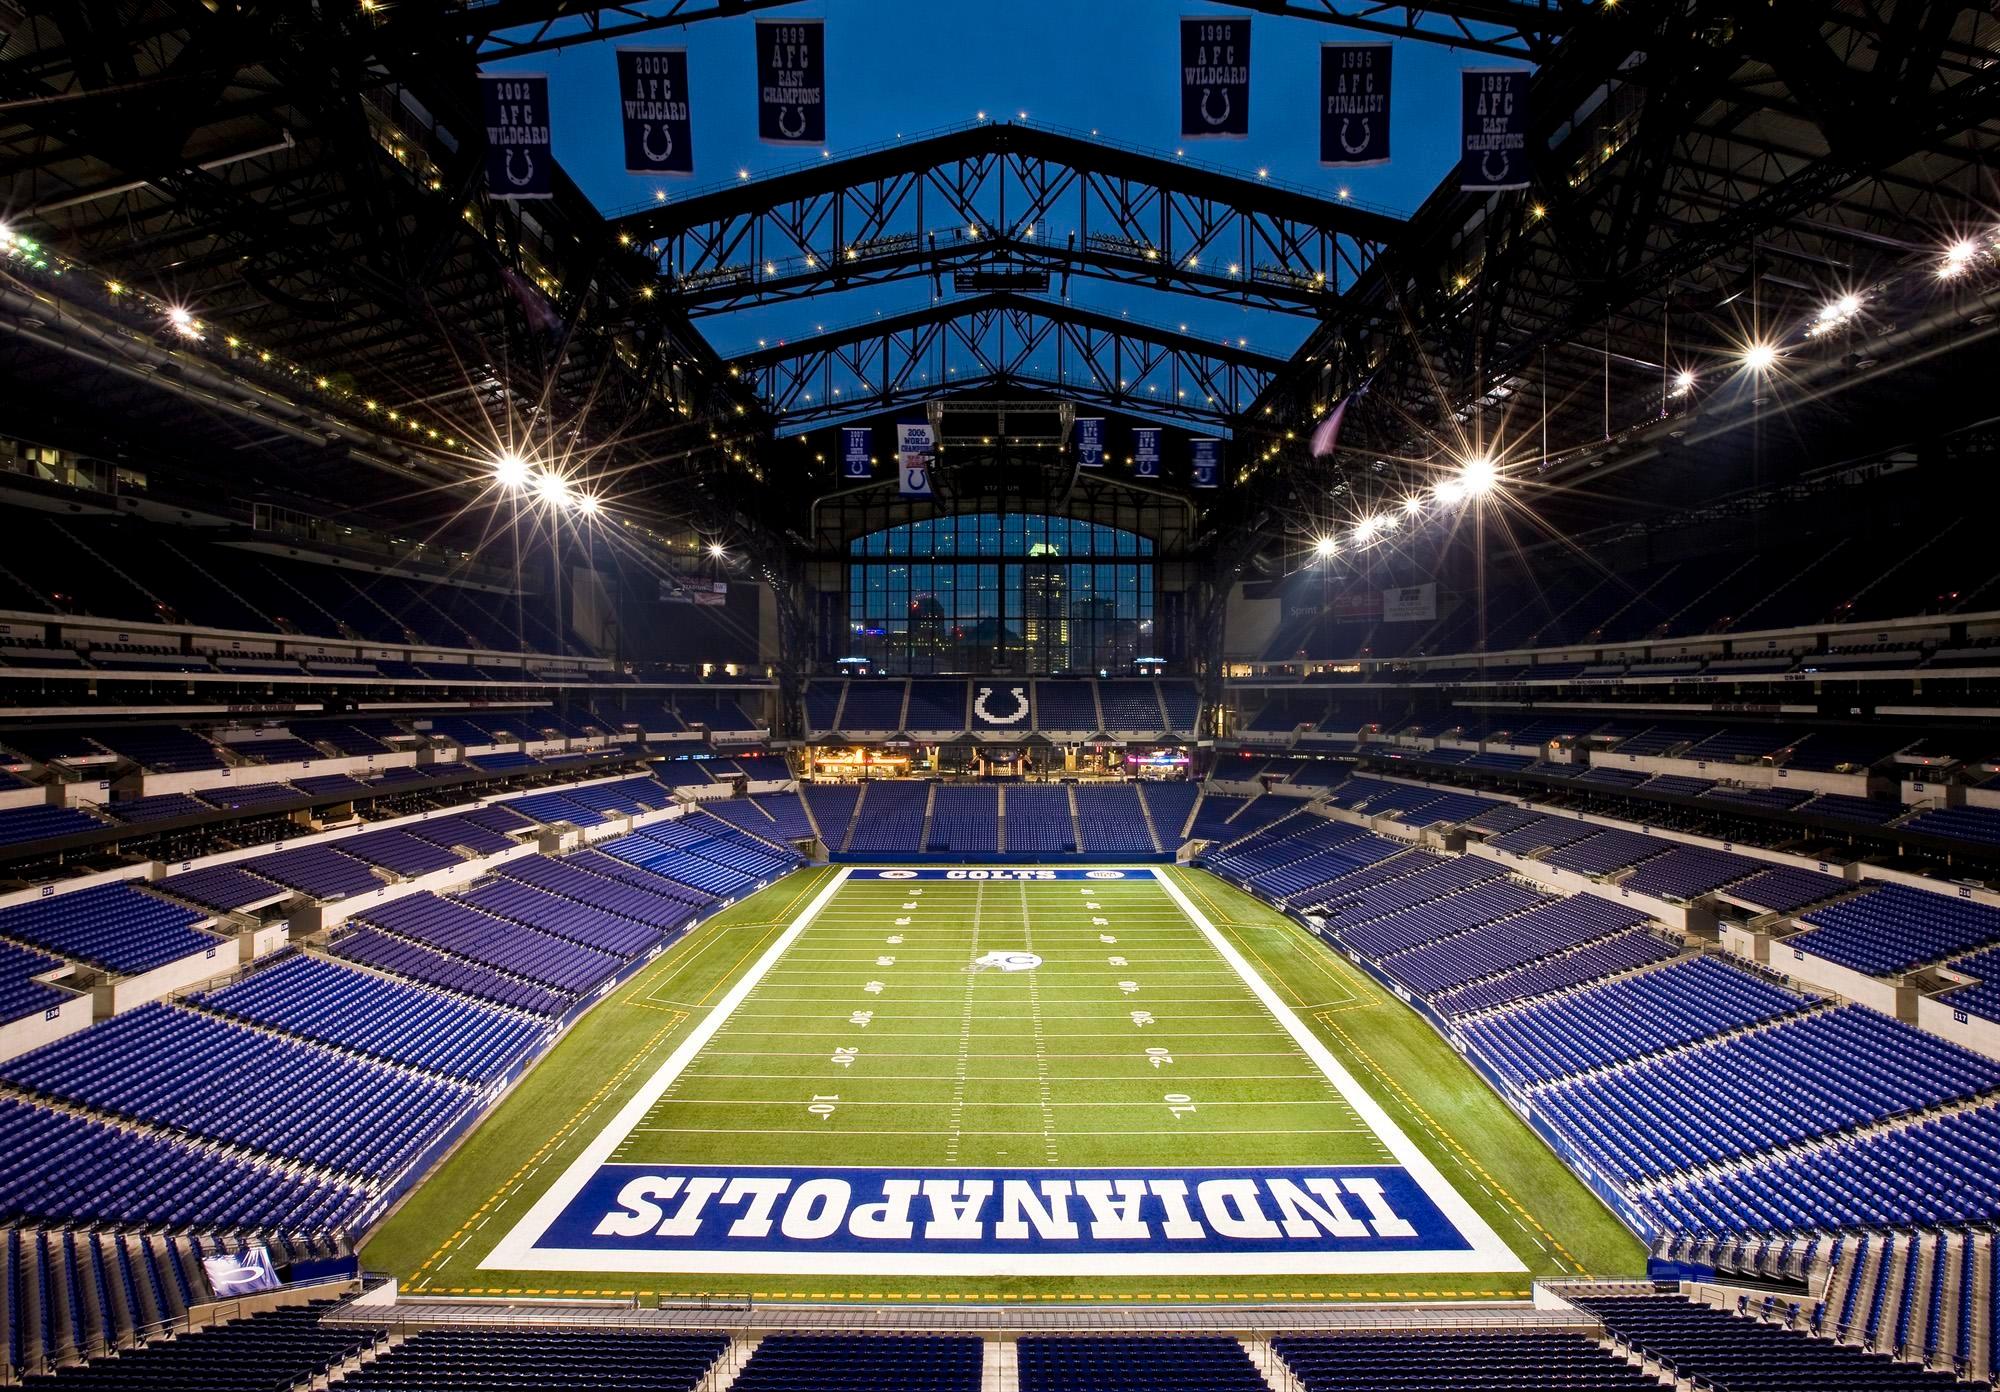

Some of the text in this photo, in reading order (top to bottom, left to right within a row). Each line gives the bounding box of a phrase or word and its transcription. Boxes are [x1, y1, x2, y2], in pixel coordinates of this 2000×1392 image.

[776, 27, 805, 43] 1999
[1201, 25, 1232, 42] 1996
[772, 45, 808, 68] AFC
[1198, 46, 1234, 66] AFC
[1342, 52, 1372, 68] 1995
[636, 56, 668, 74] 2000
[778, 70, 804, 88] EAST
[1185, 66, 1247, 85] WILDCARD
[1339, 74, 1374, 94] AFC
[1481, 76, 1512, 92] 1987
[498, 83, 530, 100] 2002
[637, 78, 672, 100] AFC
[763, 87, 820, 104] CHAMPIONS
[624, 100, 687, 121] WILDCARD
[1328, 94, 1384, 114] FINALIST
[1476, 93, 1513, 115] AFC
[500, 104, 532, 124] AFC
[1482, 117, 1508, 133] EAST
[486, 126, 548, 144] WILDCARD
[1466, 133, 1524, 150] CHAMPIONS
[946, 870, 1056, 879] COLTS
[43, 887, 53, 895] 237
[876, 956, 896, 966] 50
[1108, 956, 1128, 966] 50
[865, 981, 884, 992] 40
[1118, 981, 1140, 992] 40
[47, 1008, 59, 1020] 136
[850, 1011, 873, 1024] 30
[1130, 1011, 1155, 1024] 30
[1954, 1010, 1967, 1023] 117
[832, 1047, 859, 1064] 20
[1146, 1047, 1174, 1064] 20
[808, 1094, 840, 1115] 10
[1164, 1094, 1197, 1114] 10
[592, 1175, 1418, 1238] INDIANAPOLIS
